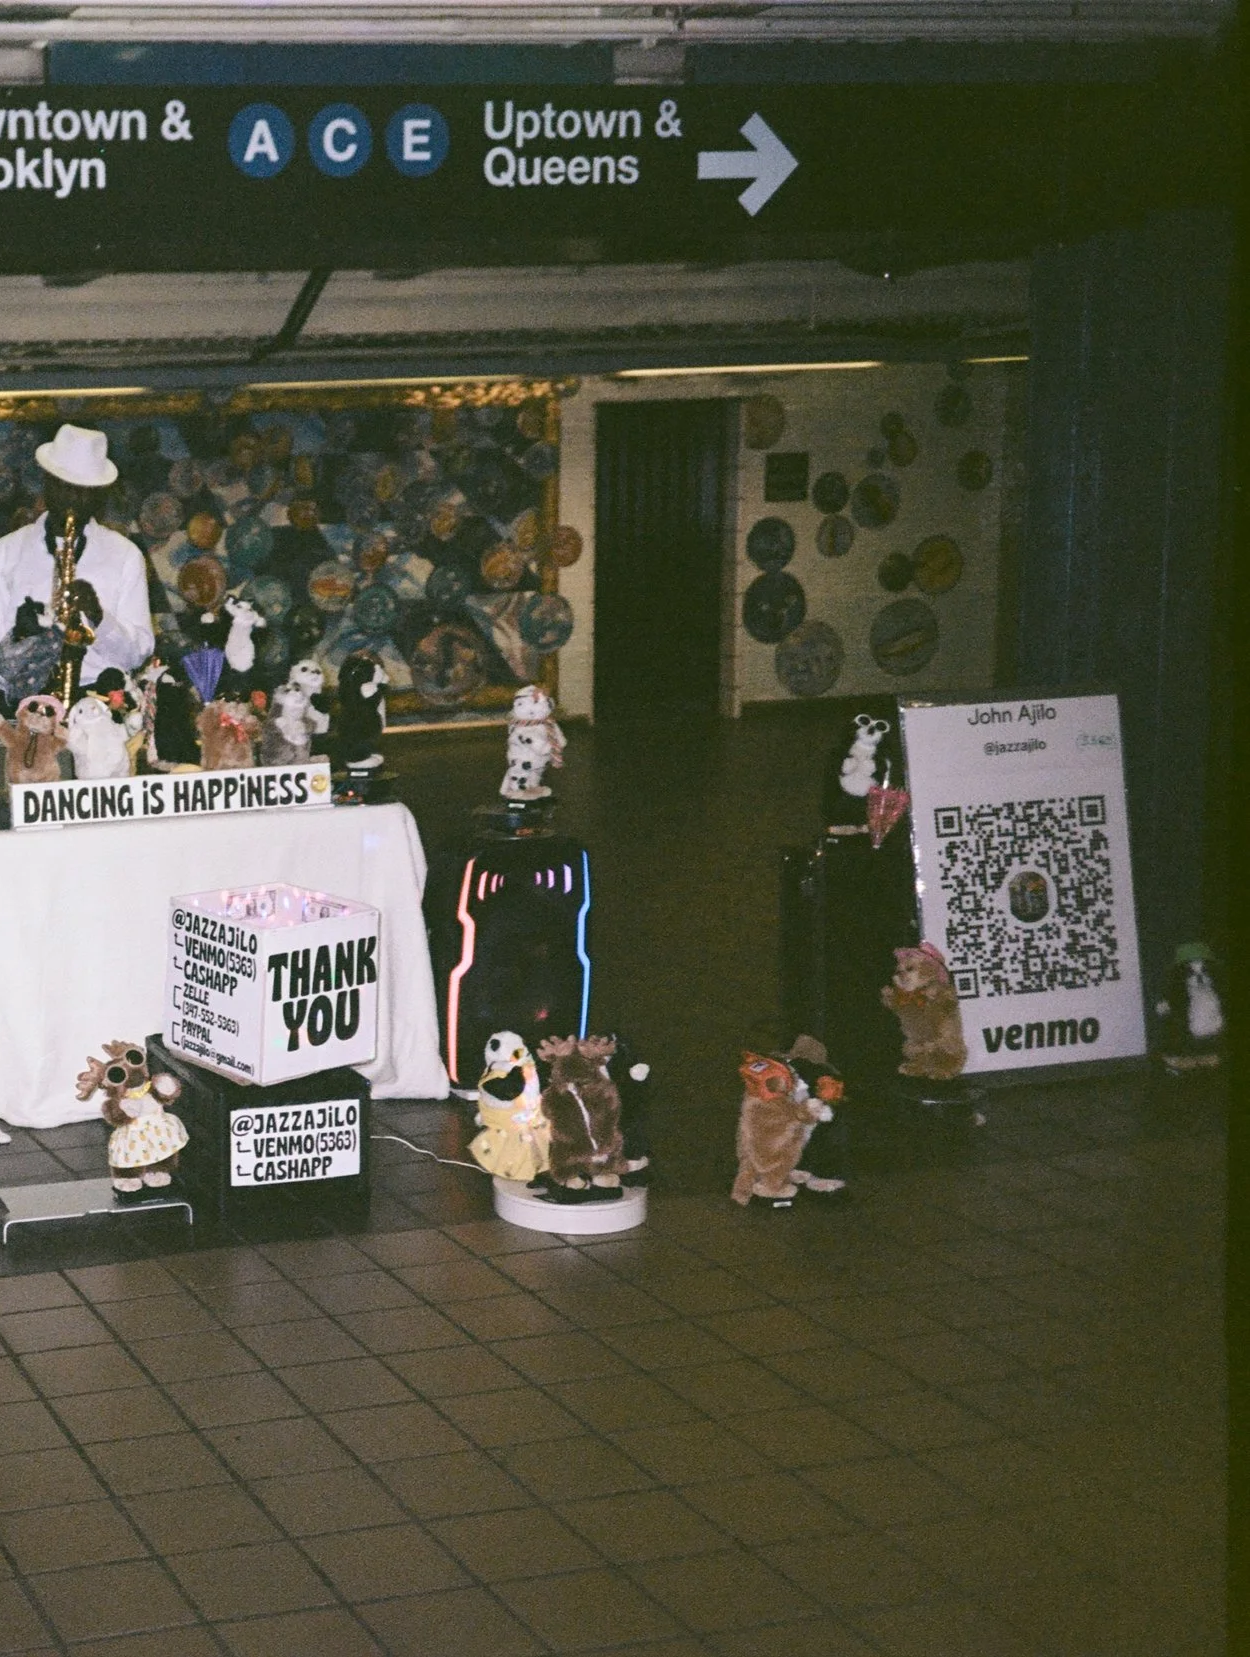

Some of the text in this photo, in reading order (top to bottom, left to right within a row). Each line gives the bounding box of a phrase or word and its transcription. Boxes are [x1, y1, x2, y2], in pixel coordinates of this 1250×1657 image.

[160, 100, 193, 142] &
[483, 99, 682, 149] Uptown &
[244, 119, 432, 164] A C E
[483, 146, 640, 188] Queens
[968, 704, 1057, 726] John Ajilo
[983, 738, 1047, 756] @jazzajilo
[22, 784, 135, 823] DANCING
[173, 771, 309, 813] HAPPiNESS
[184, 935, 257, 983] VENMO(5363)
[267, 935, 377, 1002] THANK
[183, 983, 210, 1006] ZELLE
[184, 960, 238, 997] CASHAPP
[182, 1000, 240, 1037] (347-552-5363)
[182, 1018, 212, 1044] PAYPAL
[283, 988, 361, 1053] YOU
[982, 1016, 1100, 1053] venmo
[253, 1131, 357, 1159] VENMO(5363)
[253, 1156, 333, 1182] CASHAPP
